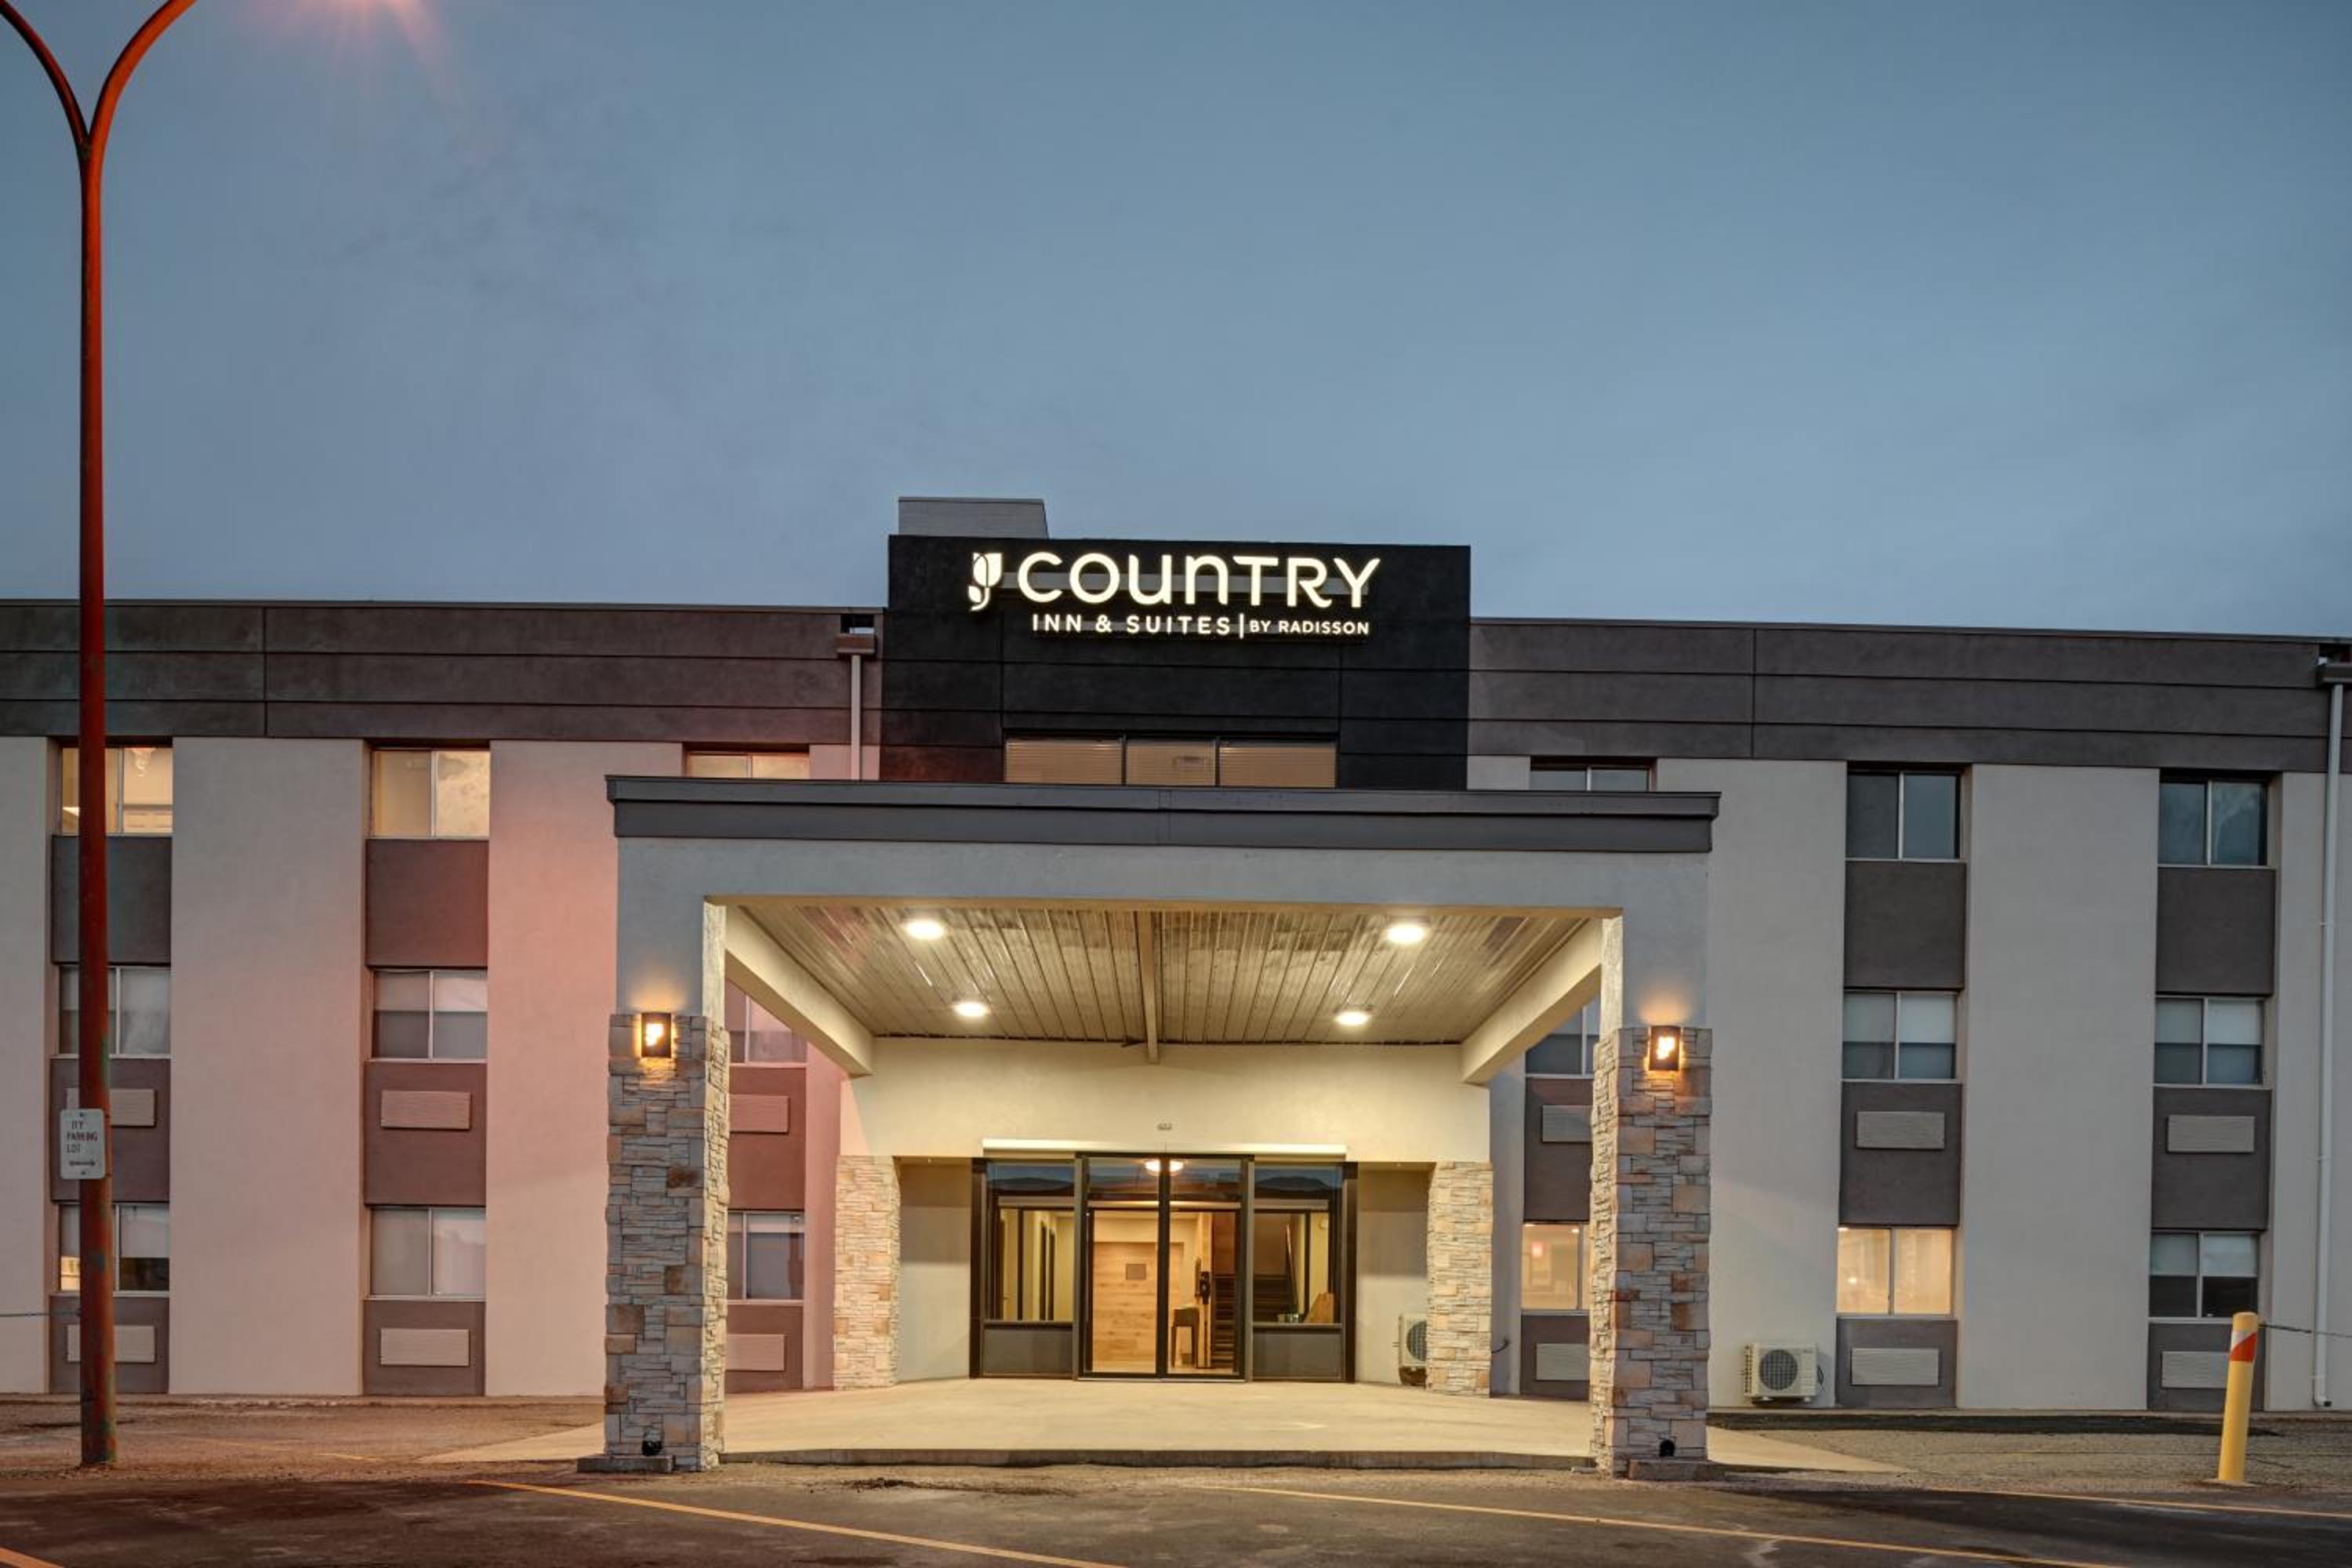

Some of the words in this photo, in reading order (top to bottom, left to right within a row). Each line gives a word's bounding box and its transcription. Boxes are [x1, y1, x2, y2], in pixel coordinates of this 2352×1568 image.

[1018, 551, 1381, 608] COUNTRY
[1032, 613, 1082, 633] INN
[1094, 613, 1113, 633] &
[1126, 614, 1230, 635] SUITES
[1249, 619, 1271, 633] BY
[1278, 619, 1369, 635] RADISSON
